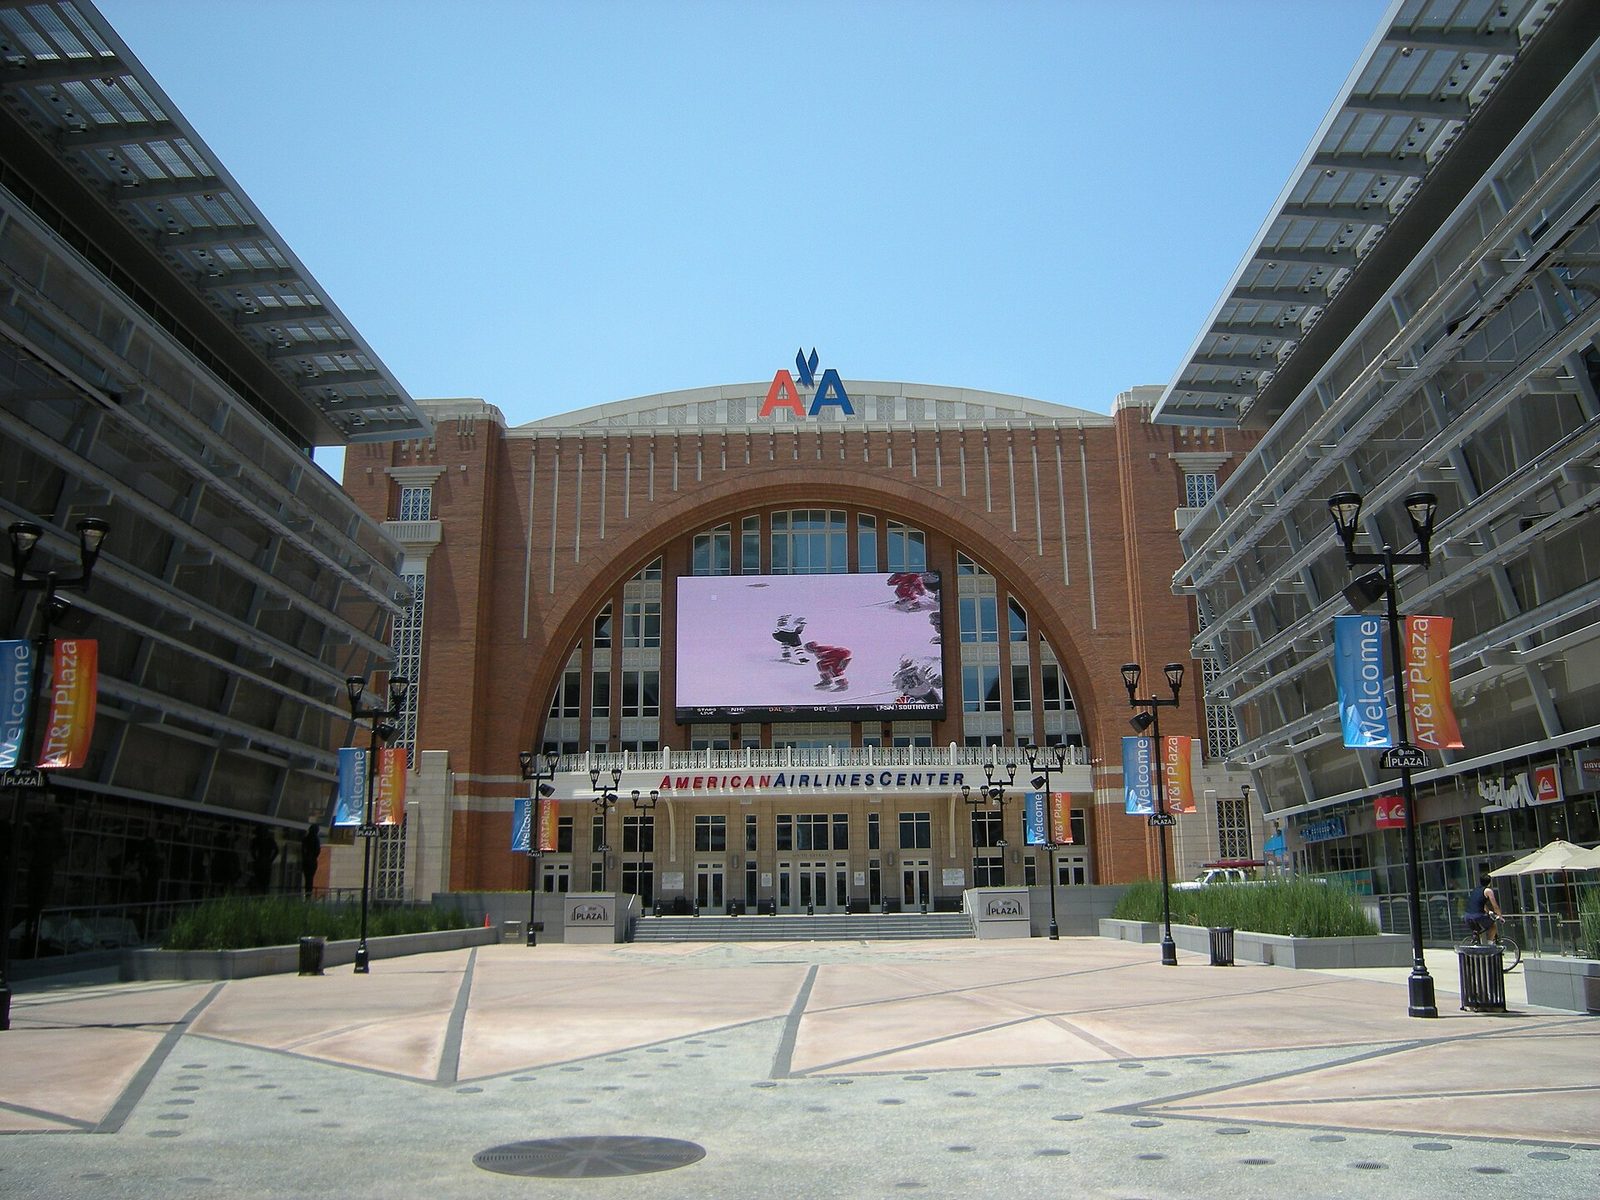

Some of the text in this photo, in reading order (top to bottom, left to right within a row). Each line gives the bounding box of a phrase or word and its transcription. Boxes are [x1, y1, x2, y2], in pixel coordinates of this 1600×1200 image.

[0, 645, 29, 767] Welcome
[45, 641, 78, 765] AT&T Plaza
[1359, 620, 1387, 746] Welcome
[1409, 618, 1440, 746] AT&T Plaza
[6, 777, 37, 786] PLAZA
[349, 751, 365, 823] Welcome
[381, 749, 395, 787] Plaza
[1136, 739, 1152, 813] Welcome
[1167, 737, 1182, 811] AT&T Plaza
[1391, 757, 1423, 766] PLAZA
[1034, 794, 1045, 843] Welcome
[1054, 792, 1063, 818] Plaza
[576, 912, 603, 920] PLAZA
[991, 907, 1018, 915] PLAZA
